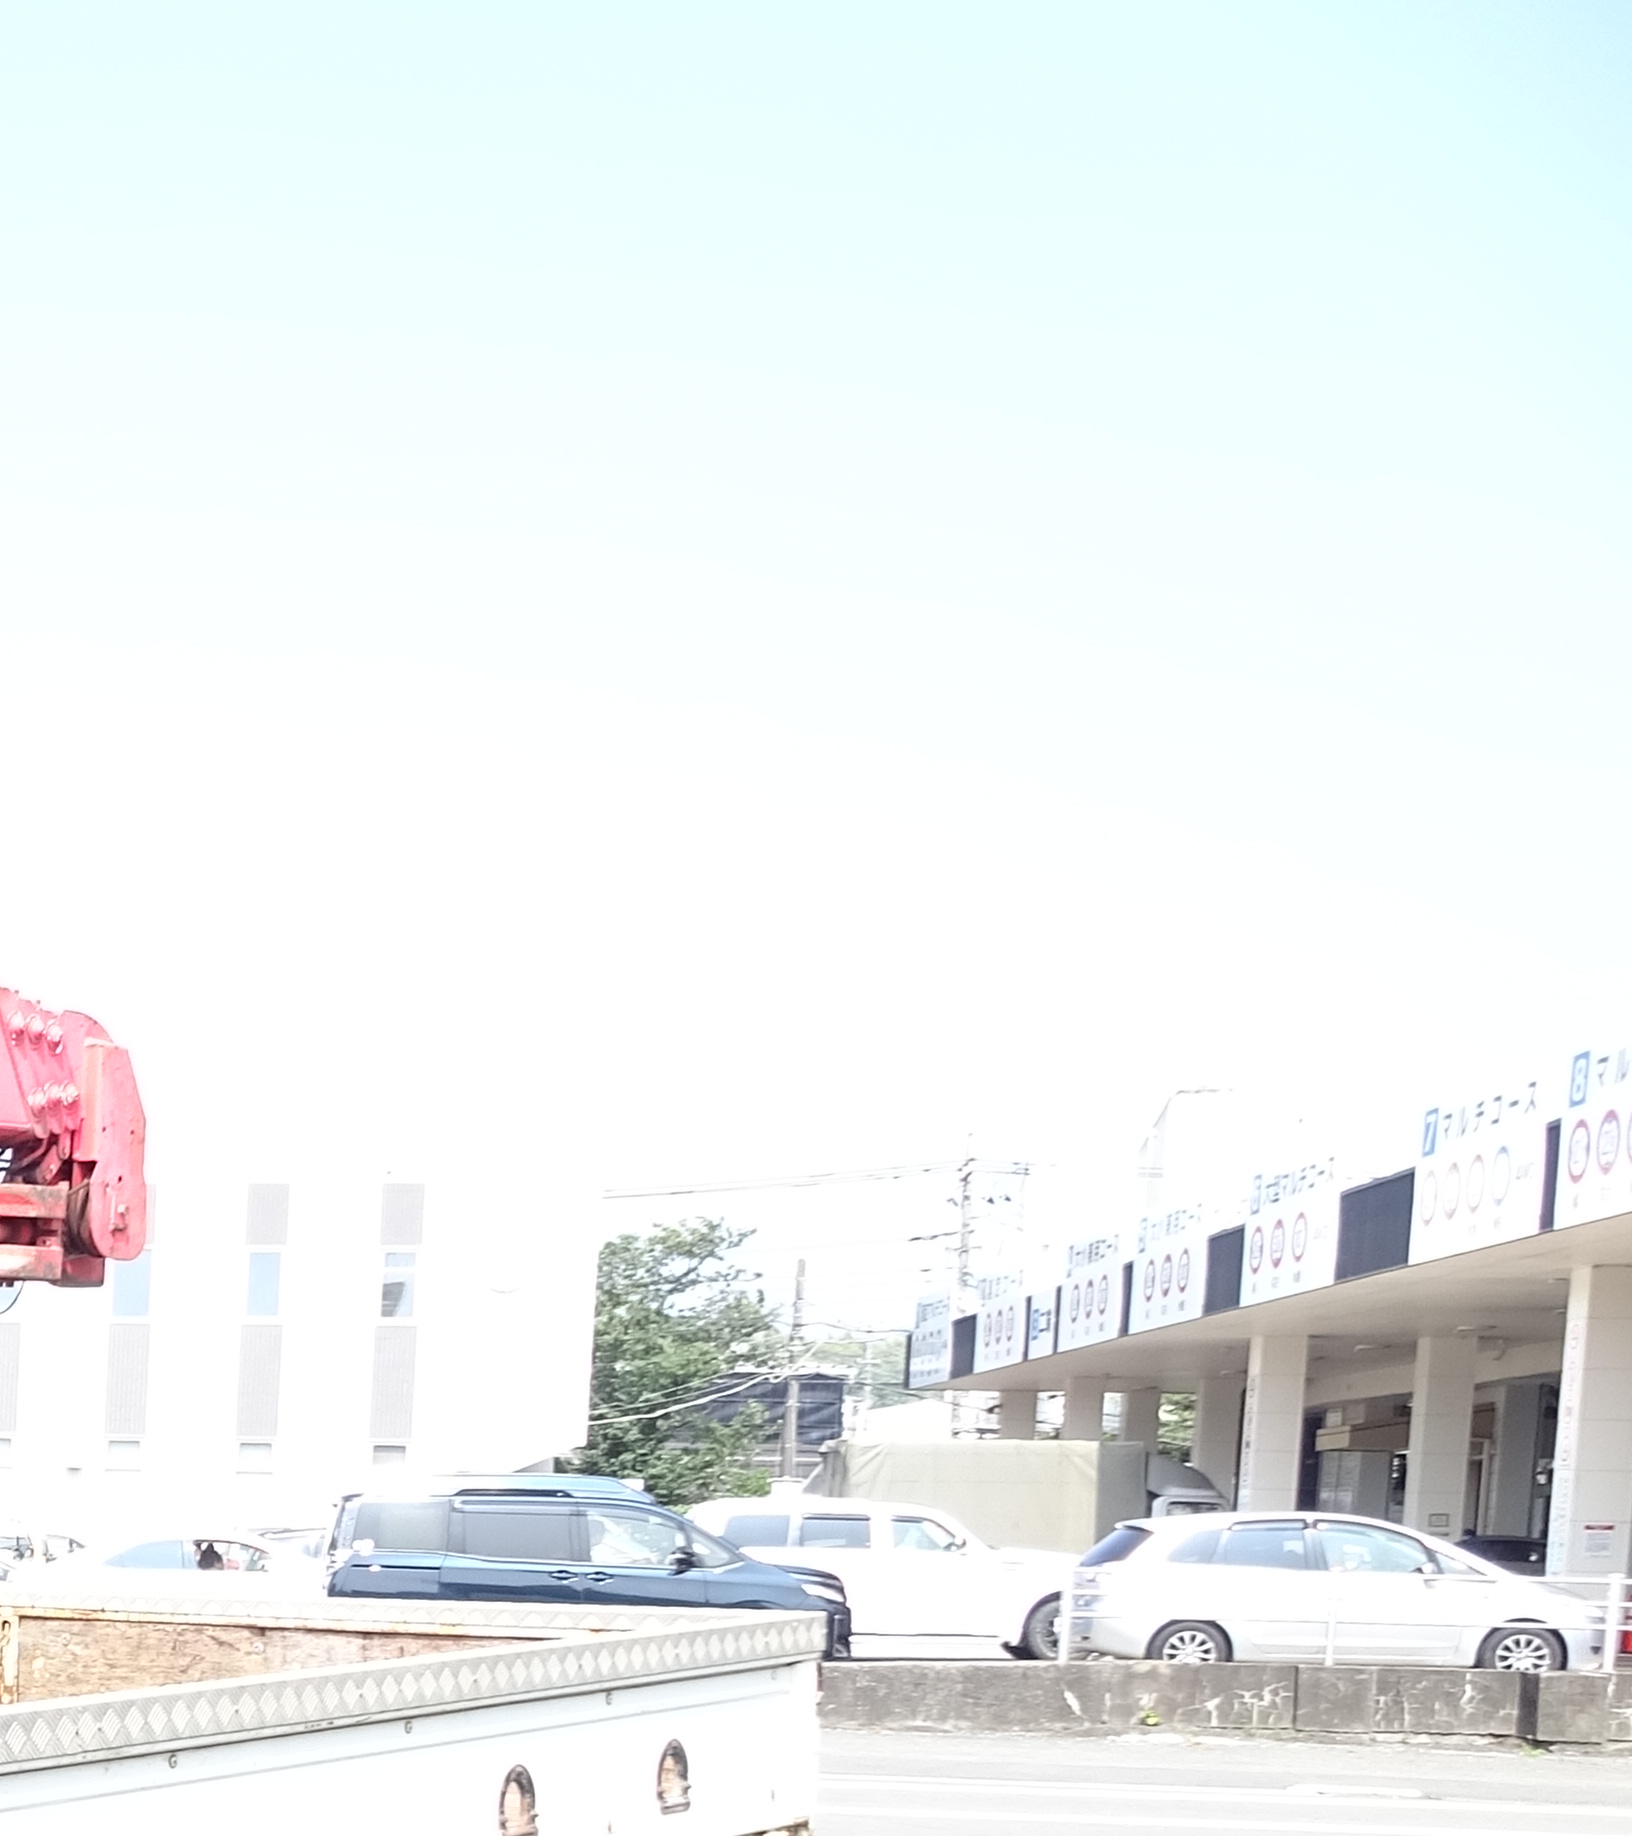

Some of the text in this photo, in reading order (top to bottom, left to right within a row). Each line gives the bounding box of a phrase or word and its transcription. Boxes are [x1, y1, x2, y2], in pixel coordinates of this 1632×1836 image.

[1570, 1053, 1590, 1106] 8
[1423, 1081, 1537, 1156] 7 マルチコース
